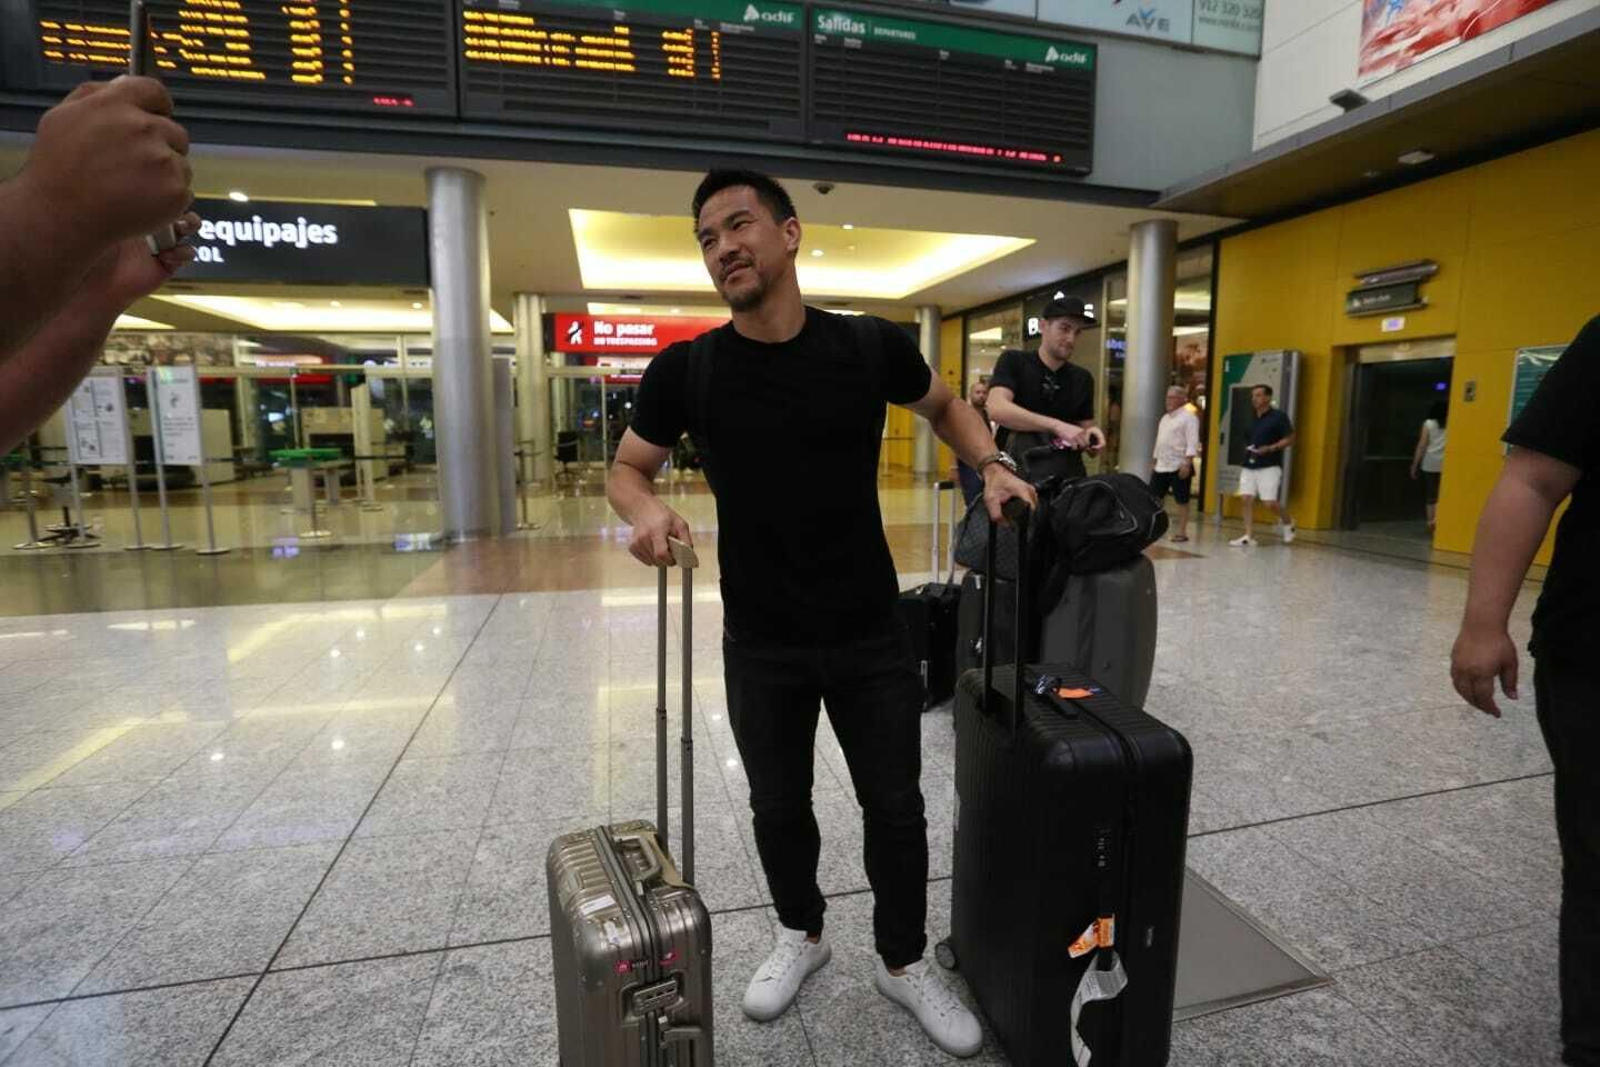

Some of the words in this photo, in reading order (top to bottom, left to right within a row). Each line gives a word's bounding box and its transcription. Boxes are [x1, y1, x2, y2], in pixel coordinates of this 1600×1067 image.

[817, 14, 866, 35] Salidas
[1126, 9, 1170, 33] AVE
[198, 215, 339, 249] equipajes
[193, 246, 226, 263] OL
[593, 320, 614, 335] No
[616, 322, 655, 338] pasar
